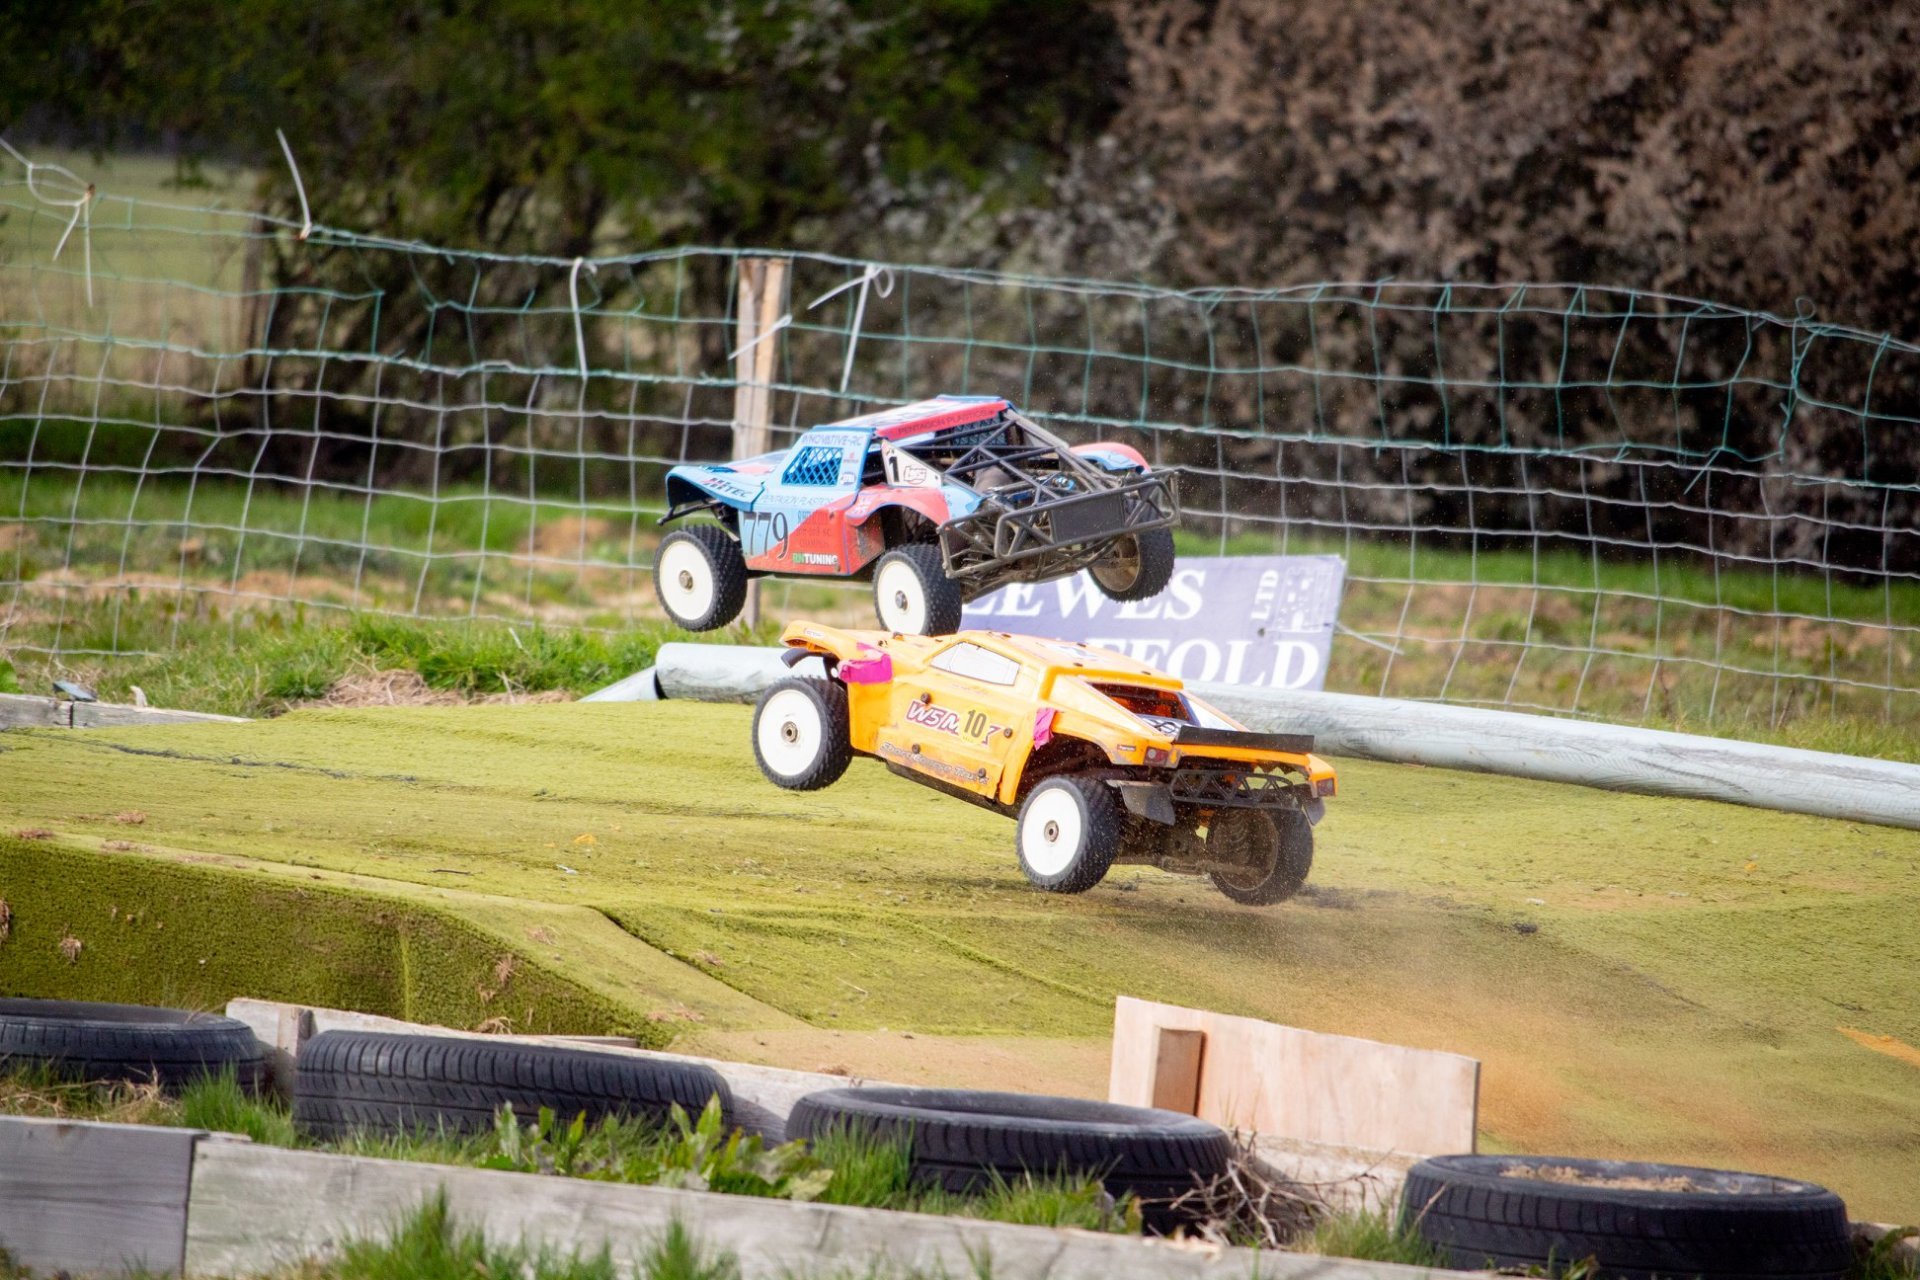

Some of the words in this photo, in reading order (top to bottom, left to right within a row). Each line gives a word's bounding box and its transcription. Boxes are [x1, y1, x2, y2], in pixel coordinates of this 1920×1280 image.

[743, 511, 789, 560] 779
[1250, 569, 1279, 620] LTD
[1084, 637, 1320, 690] FOLD
[964, 709, 987, 738] 10
